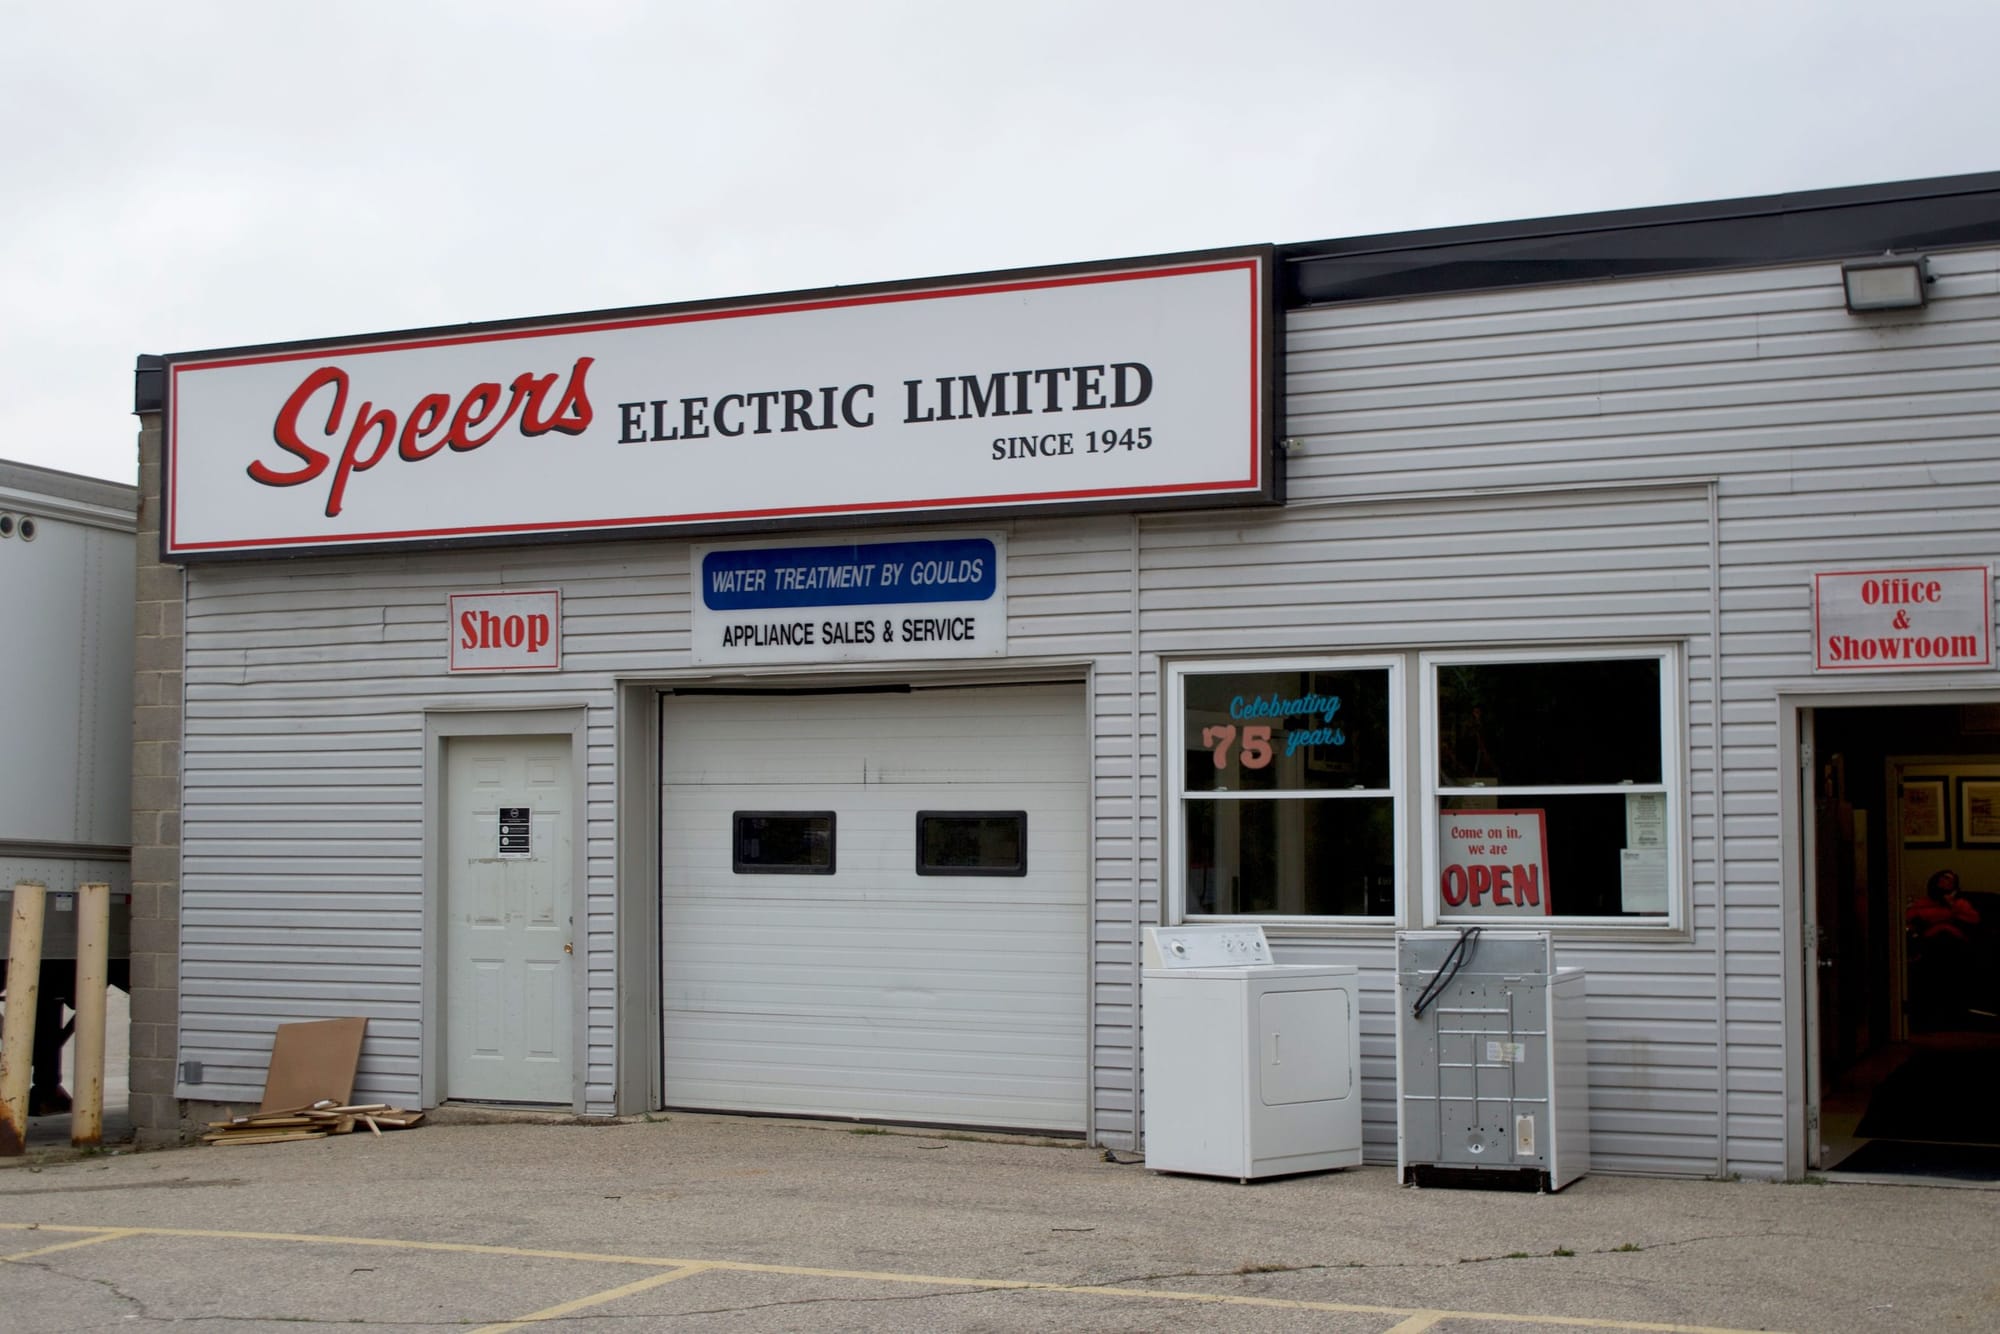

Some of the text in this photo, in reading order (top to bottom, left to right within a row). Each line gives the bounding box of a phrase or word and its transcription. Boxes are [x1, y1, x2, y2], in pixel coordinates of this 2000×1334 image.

[247, 357, 1154, 517] Speers ELECTRIC LIMITED
[991, 426, 1153, 461] SINCE 1945
[712, 558, 984, 593] WATER TREATMENT BY GOULDS
[1861, 578, 1942, 605] Office
[460, 610, 550, 653] Shop
[722, 617, 976, 647] APPLIANCE SALES & SERVICE
[1892, 609, 1911, 630] &
[1828, 635, 1978, 662] Showroom
[1230, 692, 1341, 723] Celebrating
[1202, 724, 1346, 770] 75 years
[1451, 826, 1483, 839] Come
[1487, 828, 1503, 839] on
[1468, 844, 1508, 855] we are
[1441, 863, 1540, 907] OPEN
